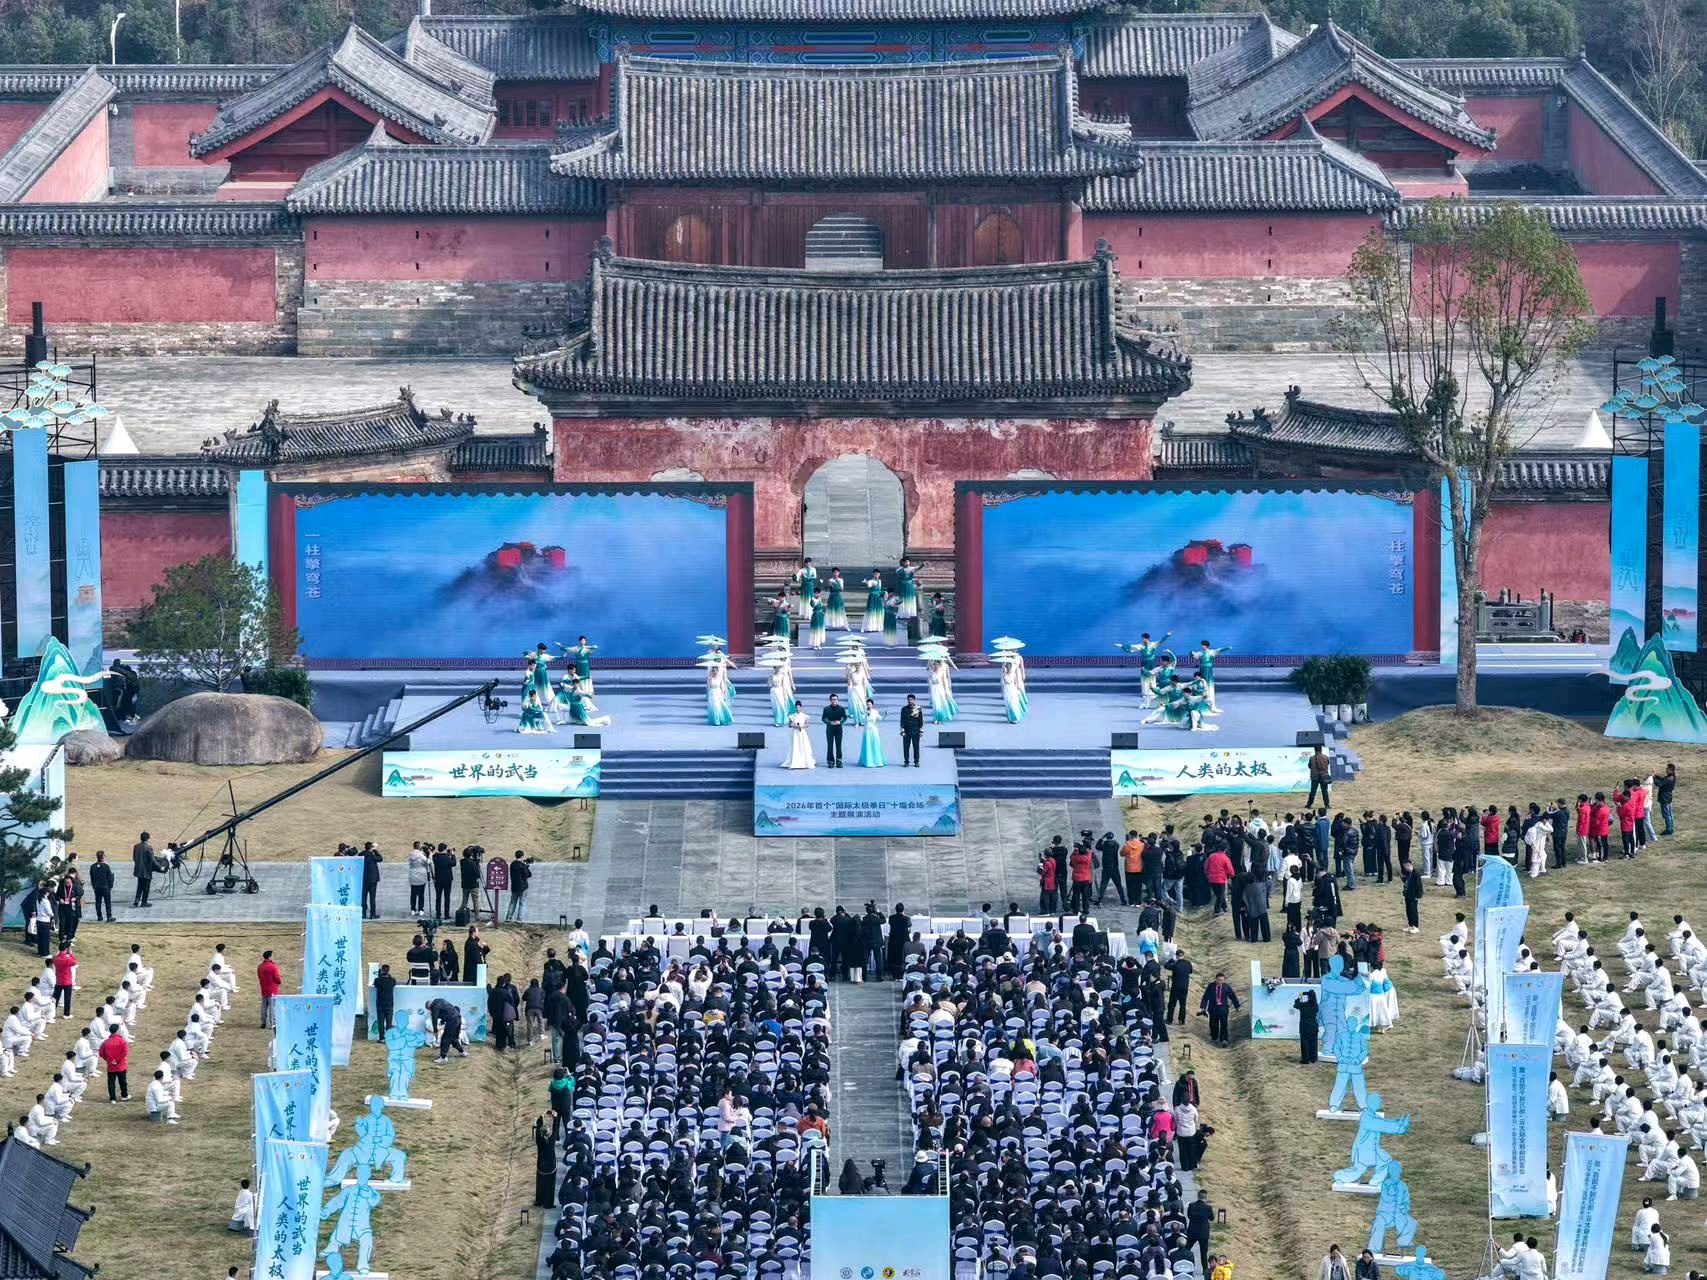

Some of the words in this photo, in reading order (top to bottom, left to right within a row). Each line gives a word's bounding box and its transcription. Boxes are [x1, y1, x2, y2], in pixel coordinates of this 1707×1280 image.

[304, 533, 320, 598] 一柱擎穹苍
[448, 762, 539, 783] 世界的武当
[1176, 760, 1273, 779] 人类的太极
[830, 811, 881, 819] 主题展演活动
[332, 935, 348, 1006] 世界的武当
[268, 1195, 294, 1279] 人类的太极
[291, 1175, 312, 1256] 世界的武当
